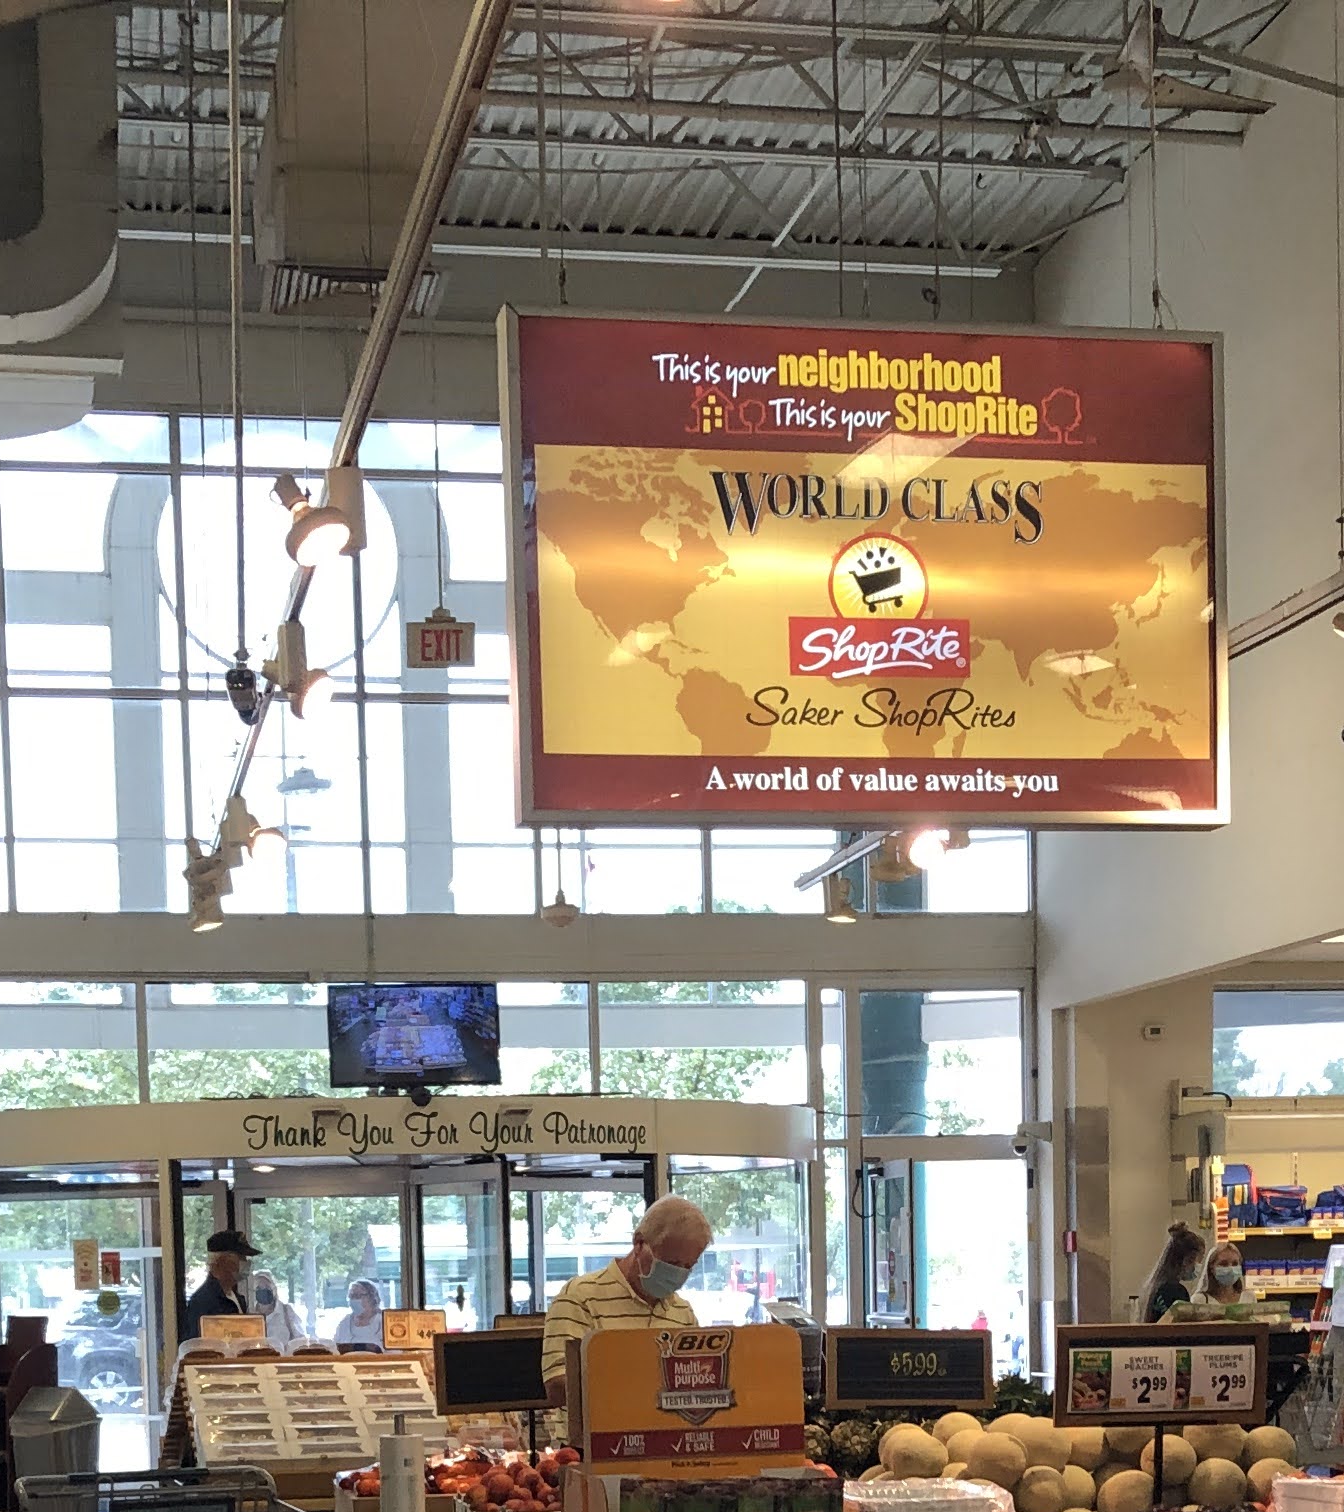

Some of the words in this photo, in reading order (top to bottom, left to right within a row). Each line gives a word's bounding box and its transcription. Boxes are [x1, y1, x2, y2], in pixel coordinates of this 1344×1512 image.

[652, 353, 697, 385] This
[704, 356, 722, 385] is
[726, 366, 776, 398] your
[777, 349, 1002, 395] neighborhood
[769, 398, 816, 428] This
[820, 400, 836, 429] is
[841, 408, 892, 442] your
[894, 393, 1038, 438] ShopRite
[709, 471, 891, 537] WORLD
[901, 476, 1045, 545] CLASS
[421, 629, 463, 661] EXIT
[799, 625, 961, 678] ShopRite
[746, 686, 844, 728] Saker
[854, 687, 1017, 736] ShopRites
[705, 766, 727, 791] A
[733, 766, 808, 792] world
[816, 767, 844, 791] of
[849, 768, 918, 792] value
[925, 768, 1006, 793] awaits
[1012, 773, 1059, 797] you
[243, 1113, 326, 1151] Thank
[337, 1111, 393, 1155] You
[404, 1111, 458, 1148] For
[469, 1111, 533, 1154] Your
[543, 1111, 646, 1153] Patronage
[677, 1334, 725, 1351] BIC
[674, 1373, 716, 1388] purpose
